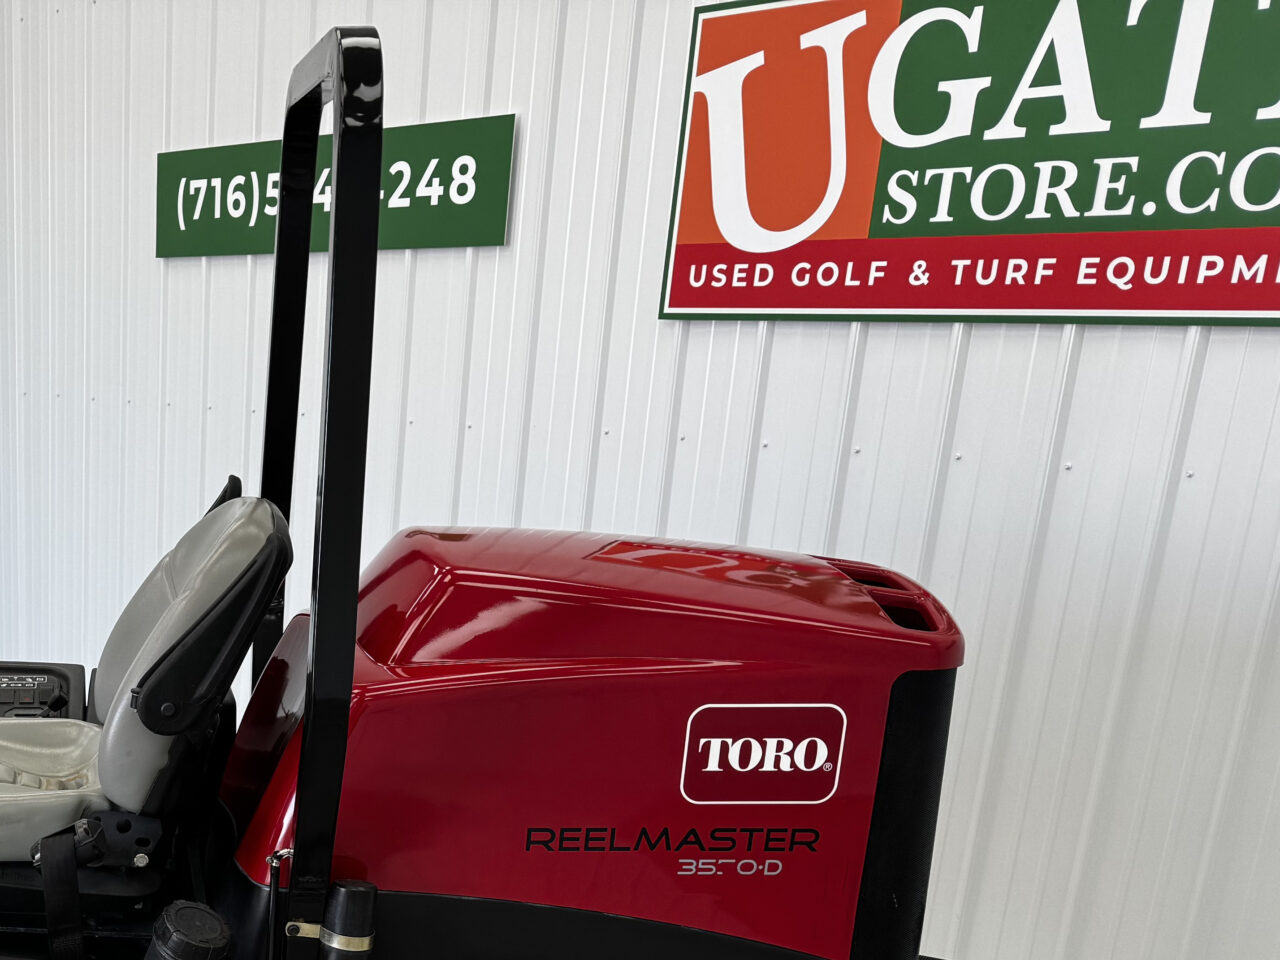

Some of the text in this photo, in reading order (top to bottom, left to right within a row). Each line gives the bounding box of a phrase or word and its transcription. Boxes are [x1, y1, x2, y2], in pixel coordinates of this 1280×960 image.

[688, 254, 1280, 290] USED GOLF & TURF EQUIPM
[525, 827, 820, 852] REELMASTER
